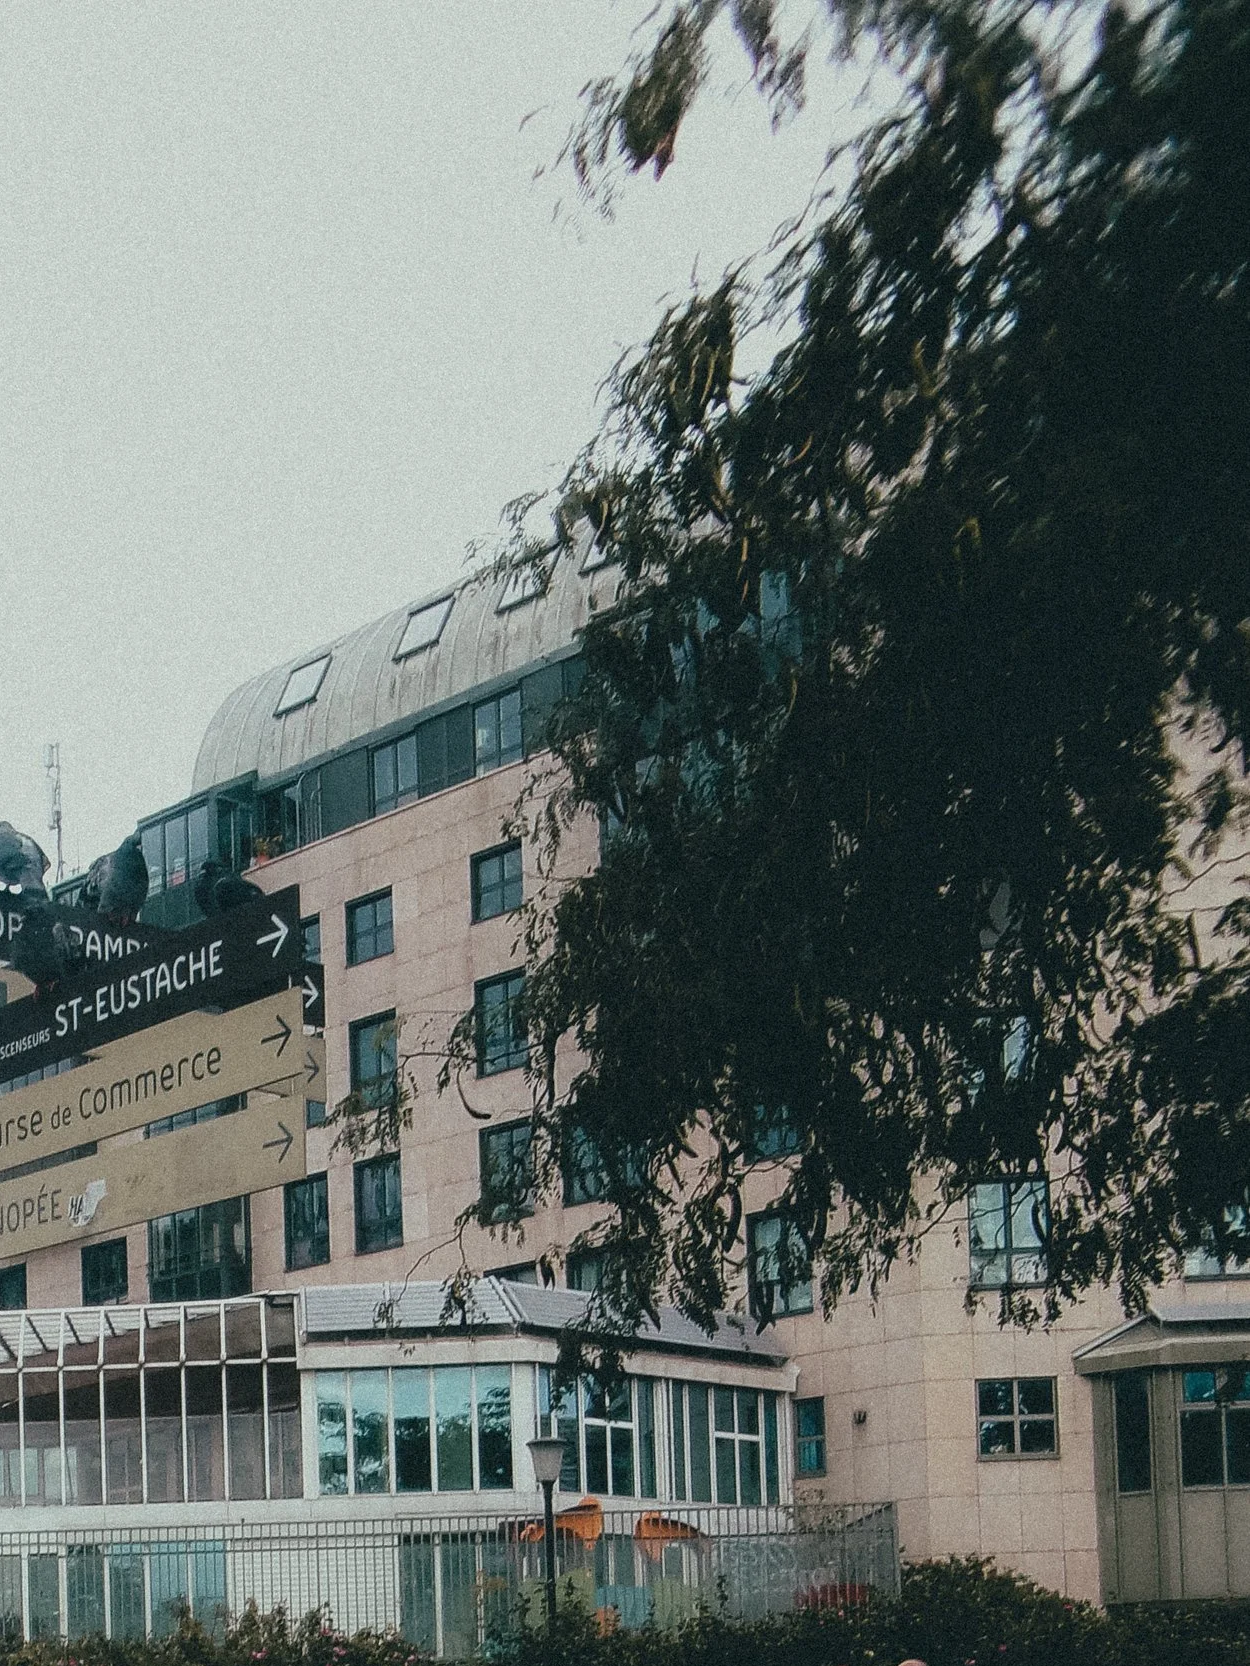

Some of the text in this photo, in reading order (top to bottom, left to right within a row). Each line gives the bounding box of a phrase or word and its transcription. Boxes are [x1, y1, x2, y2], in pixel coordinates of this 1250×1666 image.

[55, 939, 224, 1037] ST-EUSTACHE
[50, 1105, 72, 1131] de
[78, 1046, 222, 1120] Commerce
